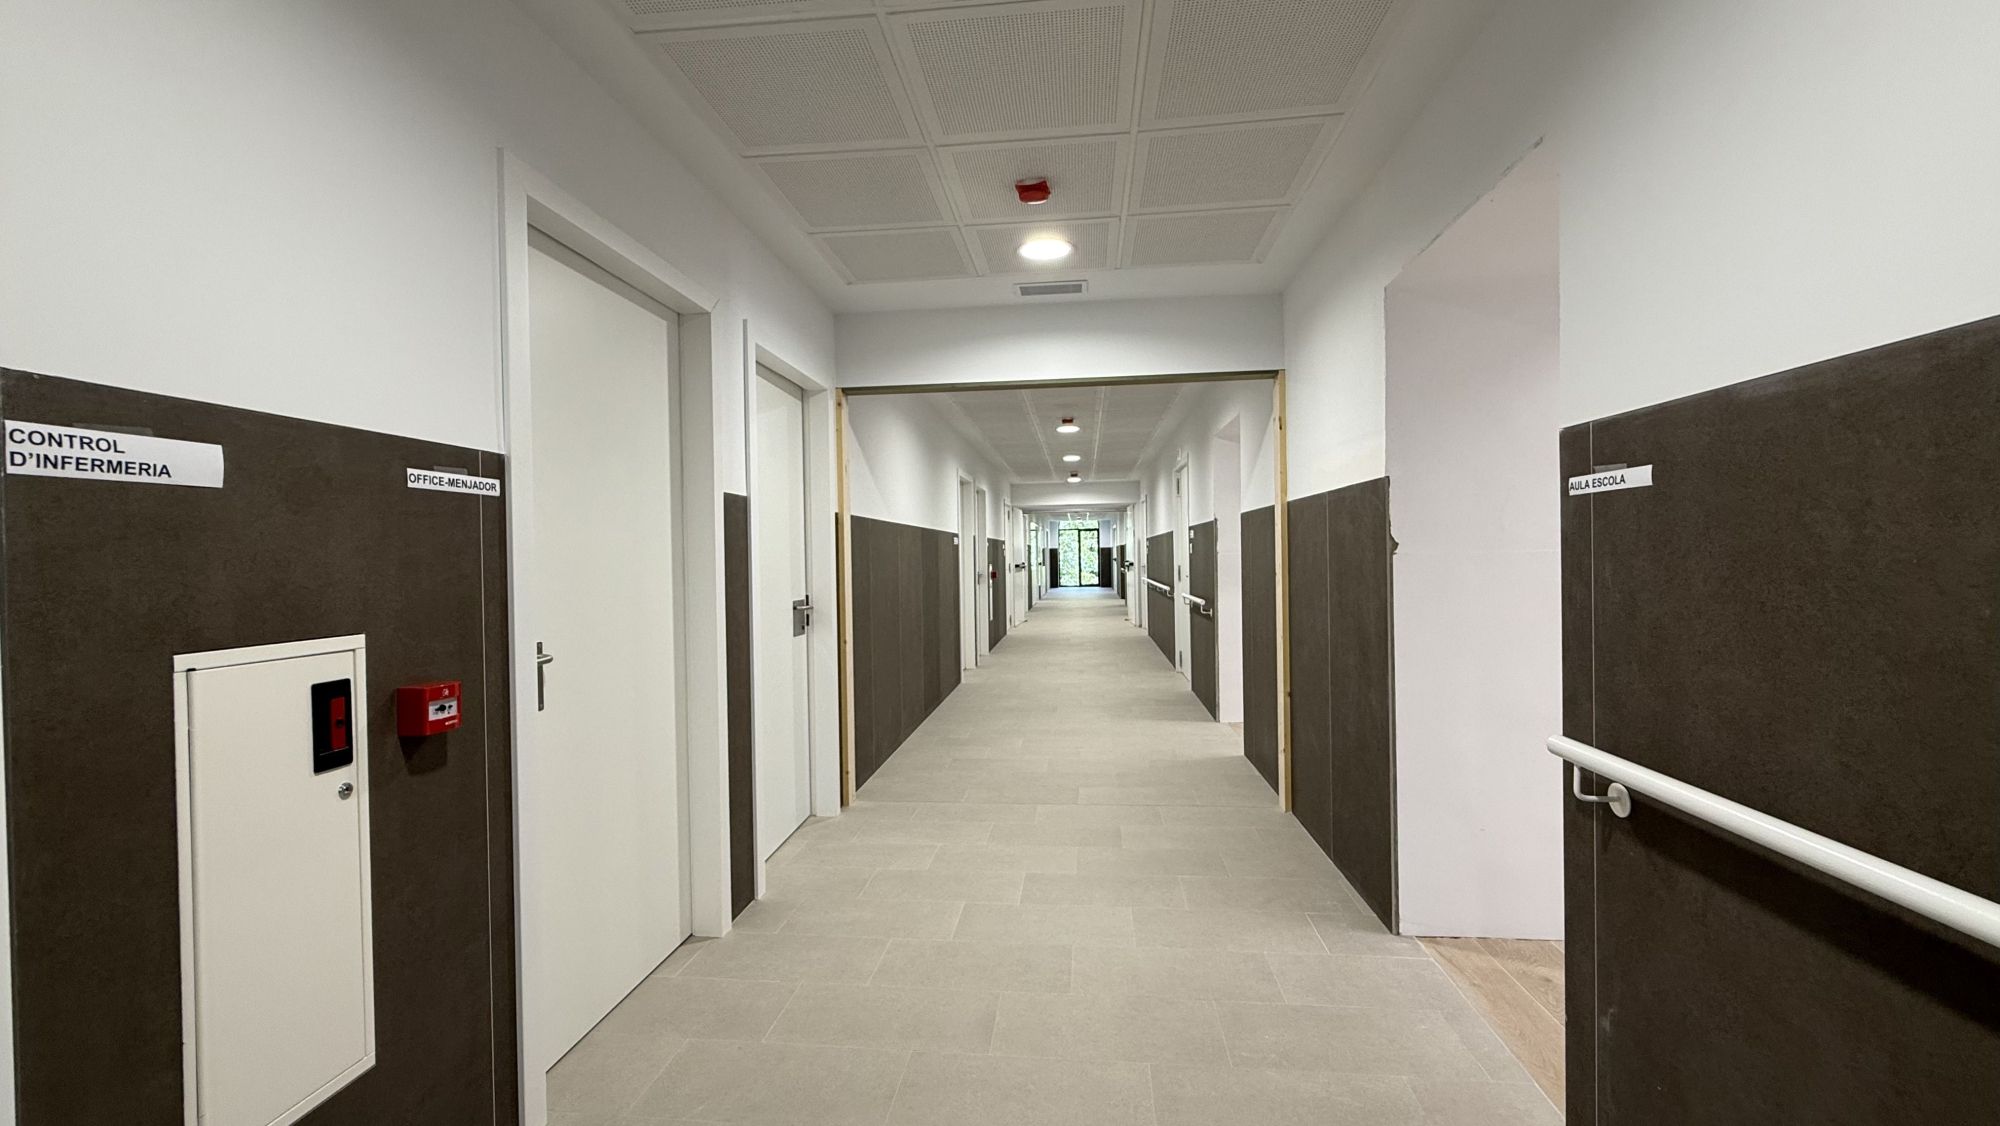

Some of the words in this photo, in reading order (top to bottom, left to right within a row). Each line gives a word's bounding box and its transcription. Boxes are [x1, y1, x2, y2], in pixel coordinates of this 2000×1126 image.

[8, 428, 126, 454] CONTROL
[9, 451, 172, 478] D’INFERMERIA
[408, 473, 497, 492] OFFICE-MENJADOR
[1569, 480, 1590, 492] AULA
[1592, 474, 1626, 488] ESCOLA
